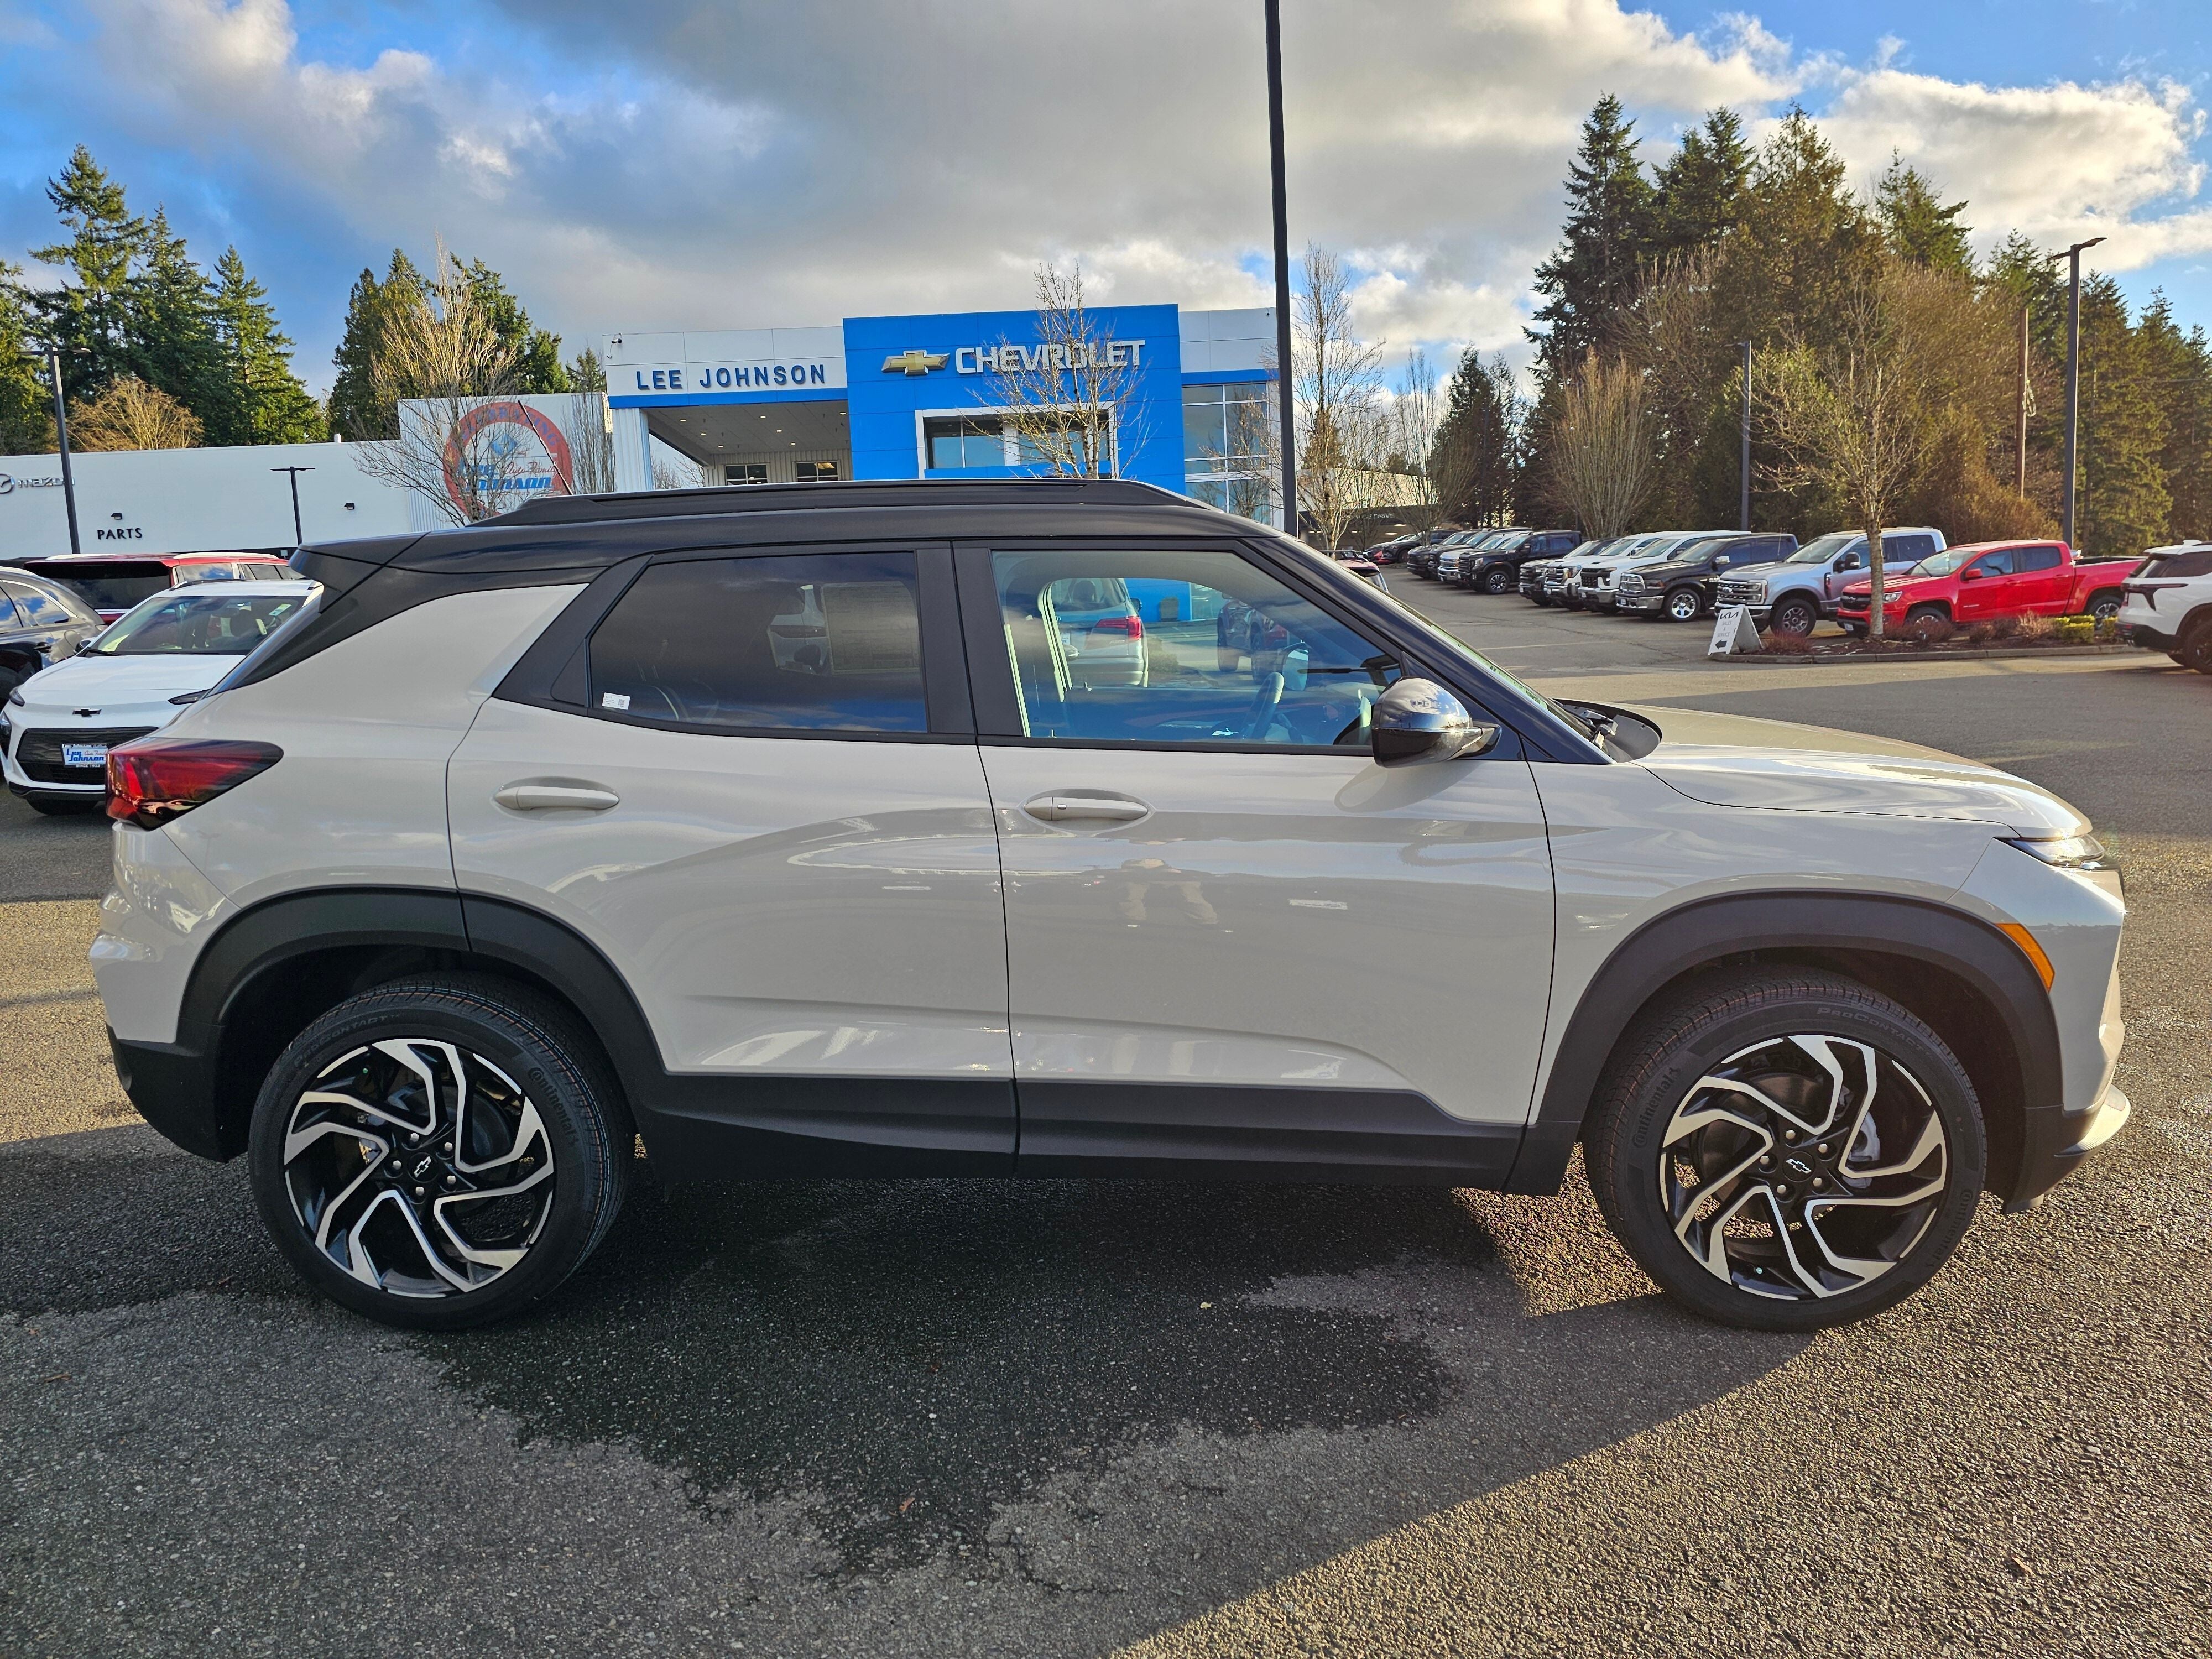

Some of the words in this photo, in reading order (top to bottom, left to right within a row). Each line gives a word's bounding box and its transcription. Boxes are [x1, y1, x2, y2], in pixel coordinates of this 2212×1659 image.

[955, 340, 1146, 374] CHEVROLET
[637, 369, 682, 390] LEE
[700, 364, 825, 388] JOHNSON
[505, 462, 525, 474] Auto
[526, 461, 559, 478] Family
[18, 477, 75, 487] mazd
[466, 473, 554, 491] ohnson
[97, 528, 143, 540] PARTS
[1720, 611, 1739, 619] KIA
[527, 1067, 577, 1135] Continental
[1632, 1074, 1675, 1148] Continental
